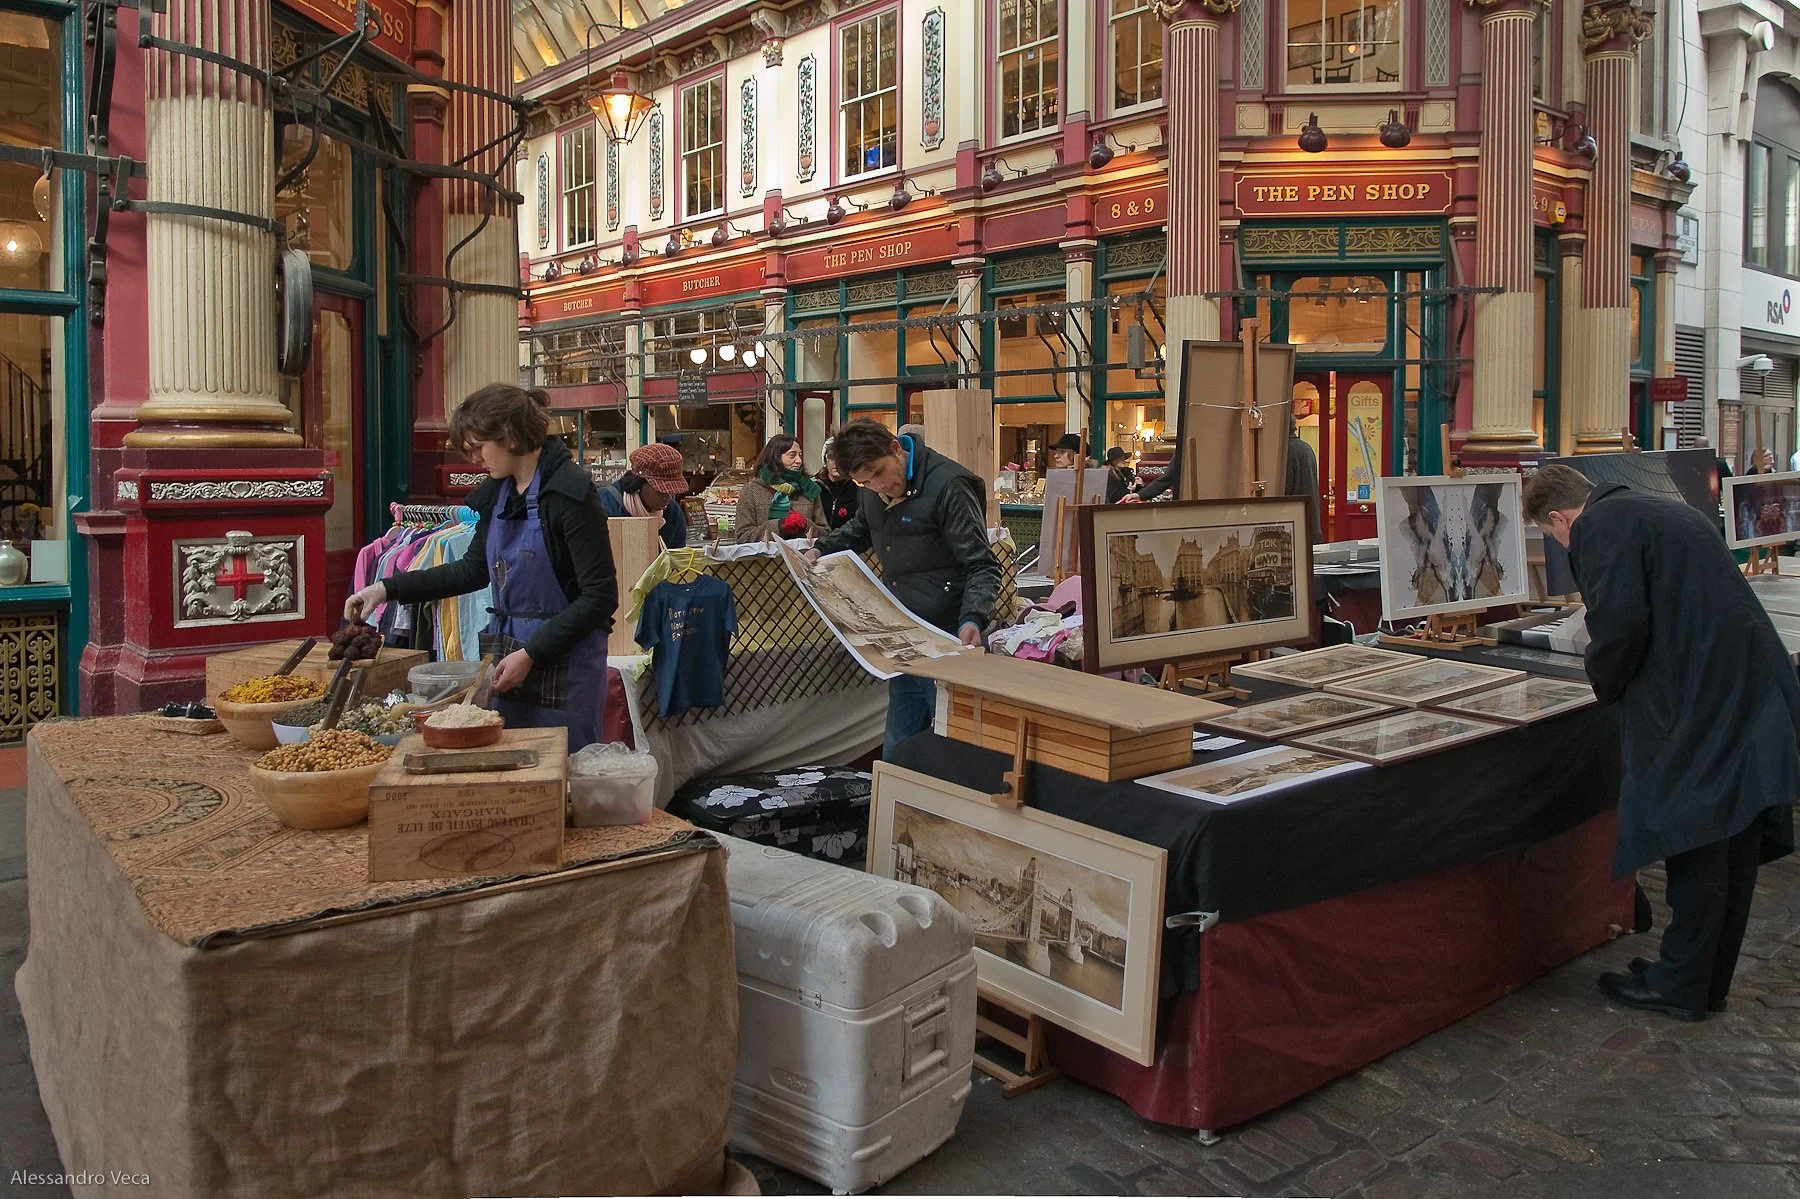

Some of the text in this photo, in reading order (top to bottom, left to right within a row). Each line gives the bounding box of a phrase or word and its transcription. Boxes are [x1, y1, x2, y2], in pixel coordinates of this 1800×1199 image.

[1002, 8, 1016, 19] BAR
[1253, 183, 1431, 202] THE PEN SHOP
[1111, 197, 1155, 219] 8 & 9
[1541, 196, 1549, 212] 9
[823, 241, 912, 269] THE PEN SHOP
[682, 275, 721, 292] BUTCHER
[759, 266, 766, 279] 7
[563, 298, 593, 312] BUTCHER
[1767, 300, 1784, 326] RSA
[1350, 395, 1380, 407] Gifts
[385, 791, 408, 801] 2000
[431, 807, 507, 819] MARGAUX
[397, 822, 423, 833] LUZE
[428, 821, 442, 832] DE
[446, 820, 482, 831] PAVEIL
